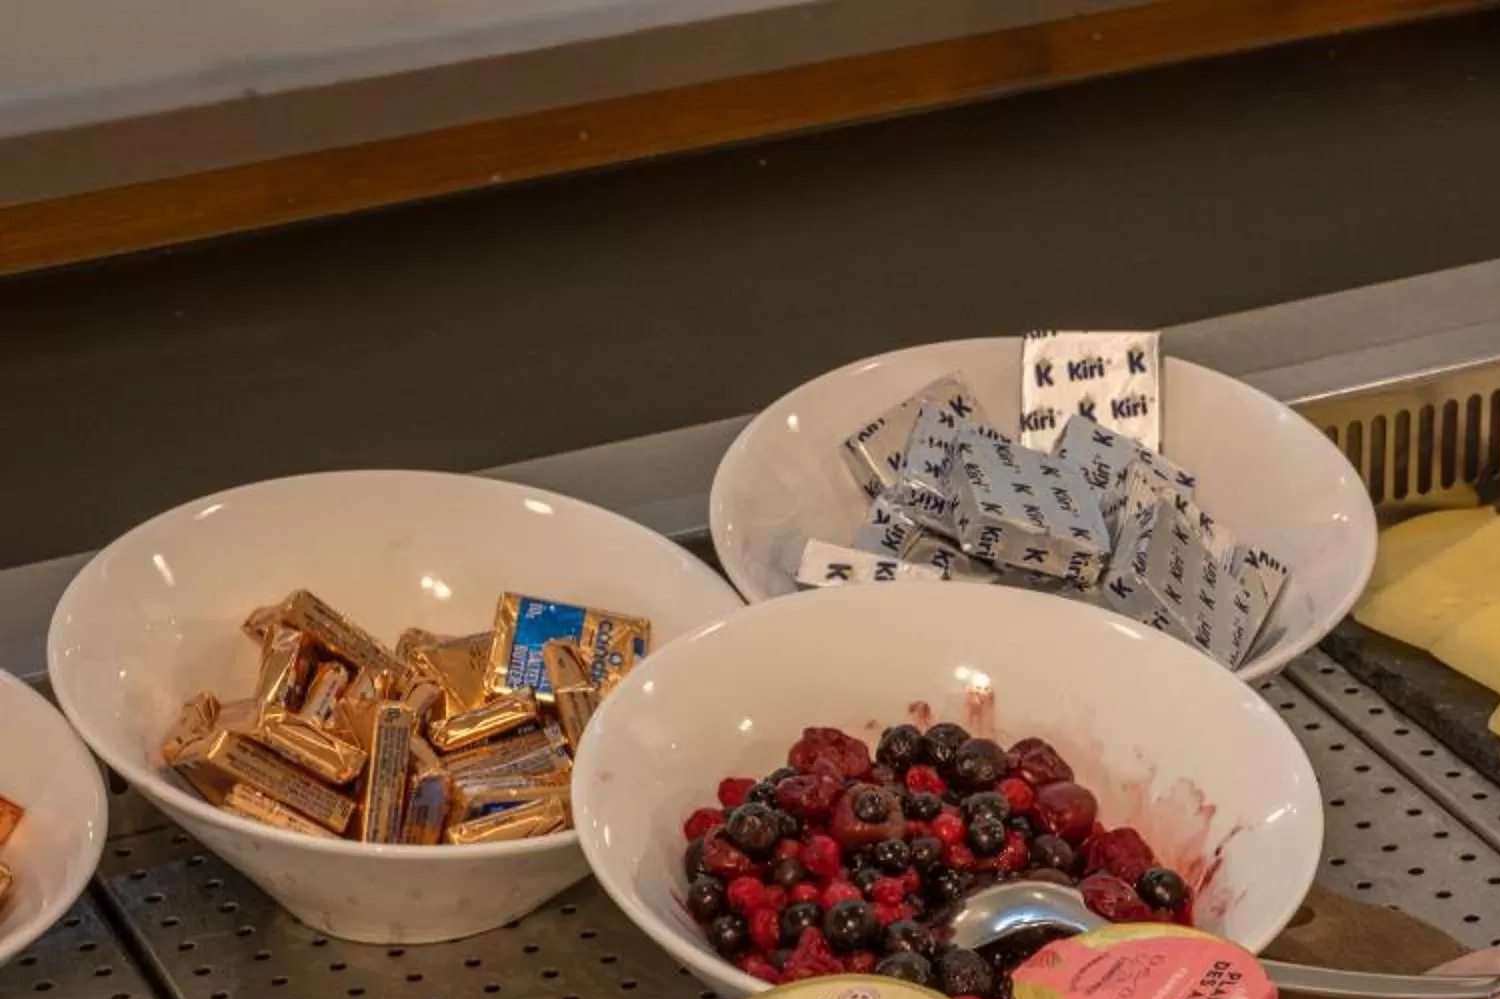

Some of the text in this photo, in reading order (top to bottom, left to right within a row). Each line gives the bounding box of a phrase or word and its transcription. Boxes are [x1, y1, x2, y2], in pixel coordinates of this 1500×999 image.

[1035, 351, 1147, 389] K Kiri K
[949, 395, 973, 418] K
[1020, 408, 1056, 432] Kiri
[1111, 395, 1148, 420] Kiri
[1092, 430, 1115, 447] K
[1012, 482, 1035, 496] K
[1175, 471, 1196, 489] K
[980, 502, 1002, 515] K
[1069, 527, 1092, 542] K
[1023, 548, 1049, 564] K
[825, 563, 853, 582] K
[874, 562, 898, 581] Ki
[1108, 577, 1134, 600] K
